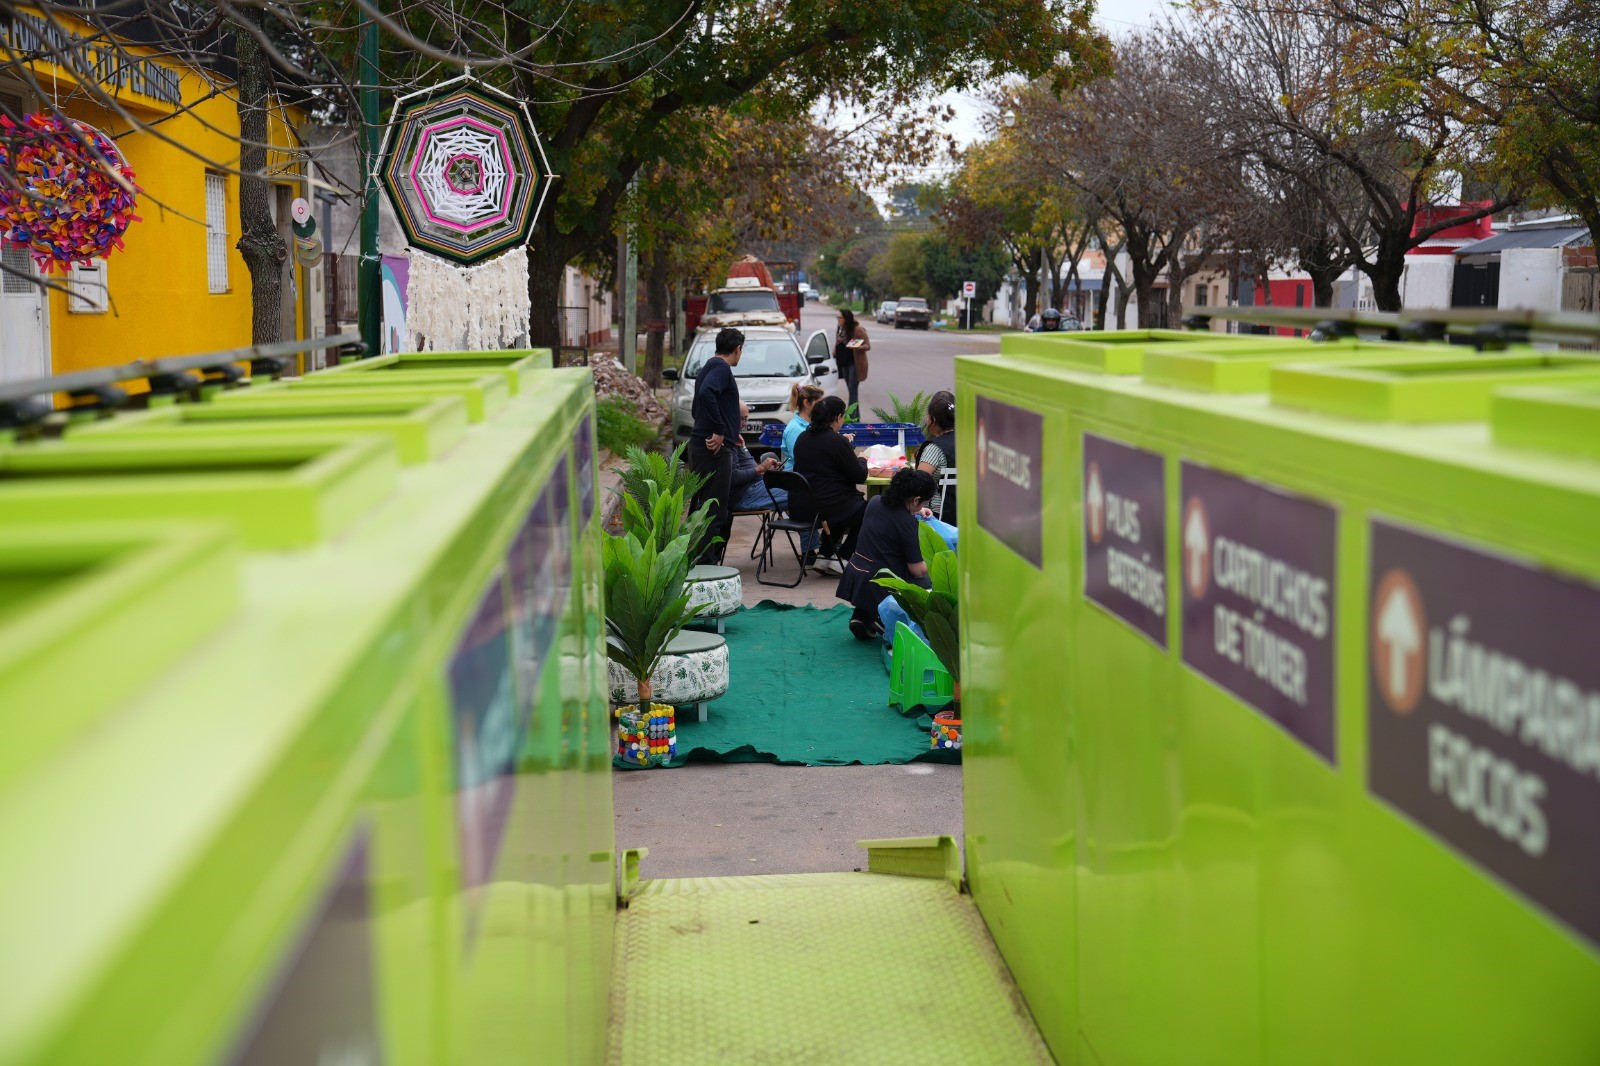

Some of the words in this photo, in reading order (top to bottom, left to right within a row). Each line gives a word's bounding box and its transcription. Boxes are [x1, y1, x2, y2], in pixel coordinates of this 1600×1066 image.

[146, 61, 180, 105] MOLINO
[1106, 491, 1140, 544] PILAS
[1107, 547, 1165, 617] BATERÍAS
[1213, 535, 1328, 639] CARTUCHOS
[1214, 603, 1241, 664] DE
[1243, 610, 1308, 706] TÓNER
[1428, 720, 1549, 858] FOCOS
